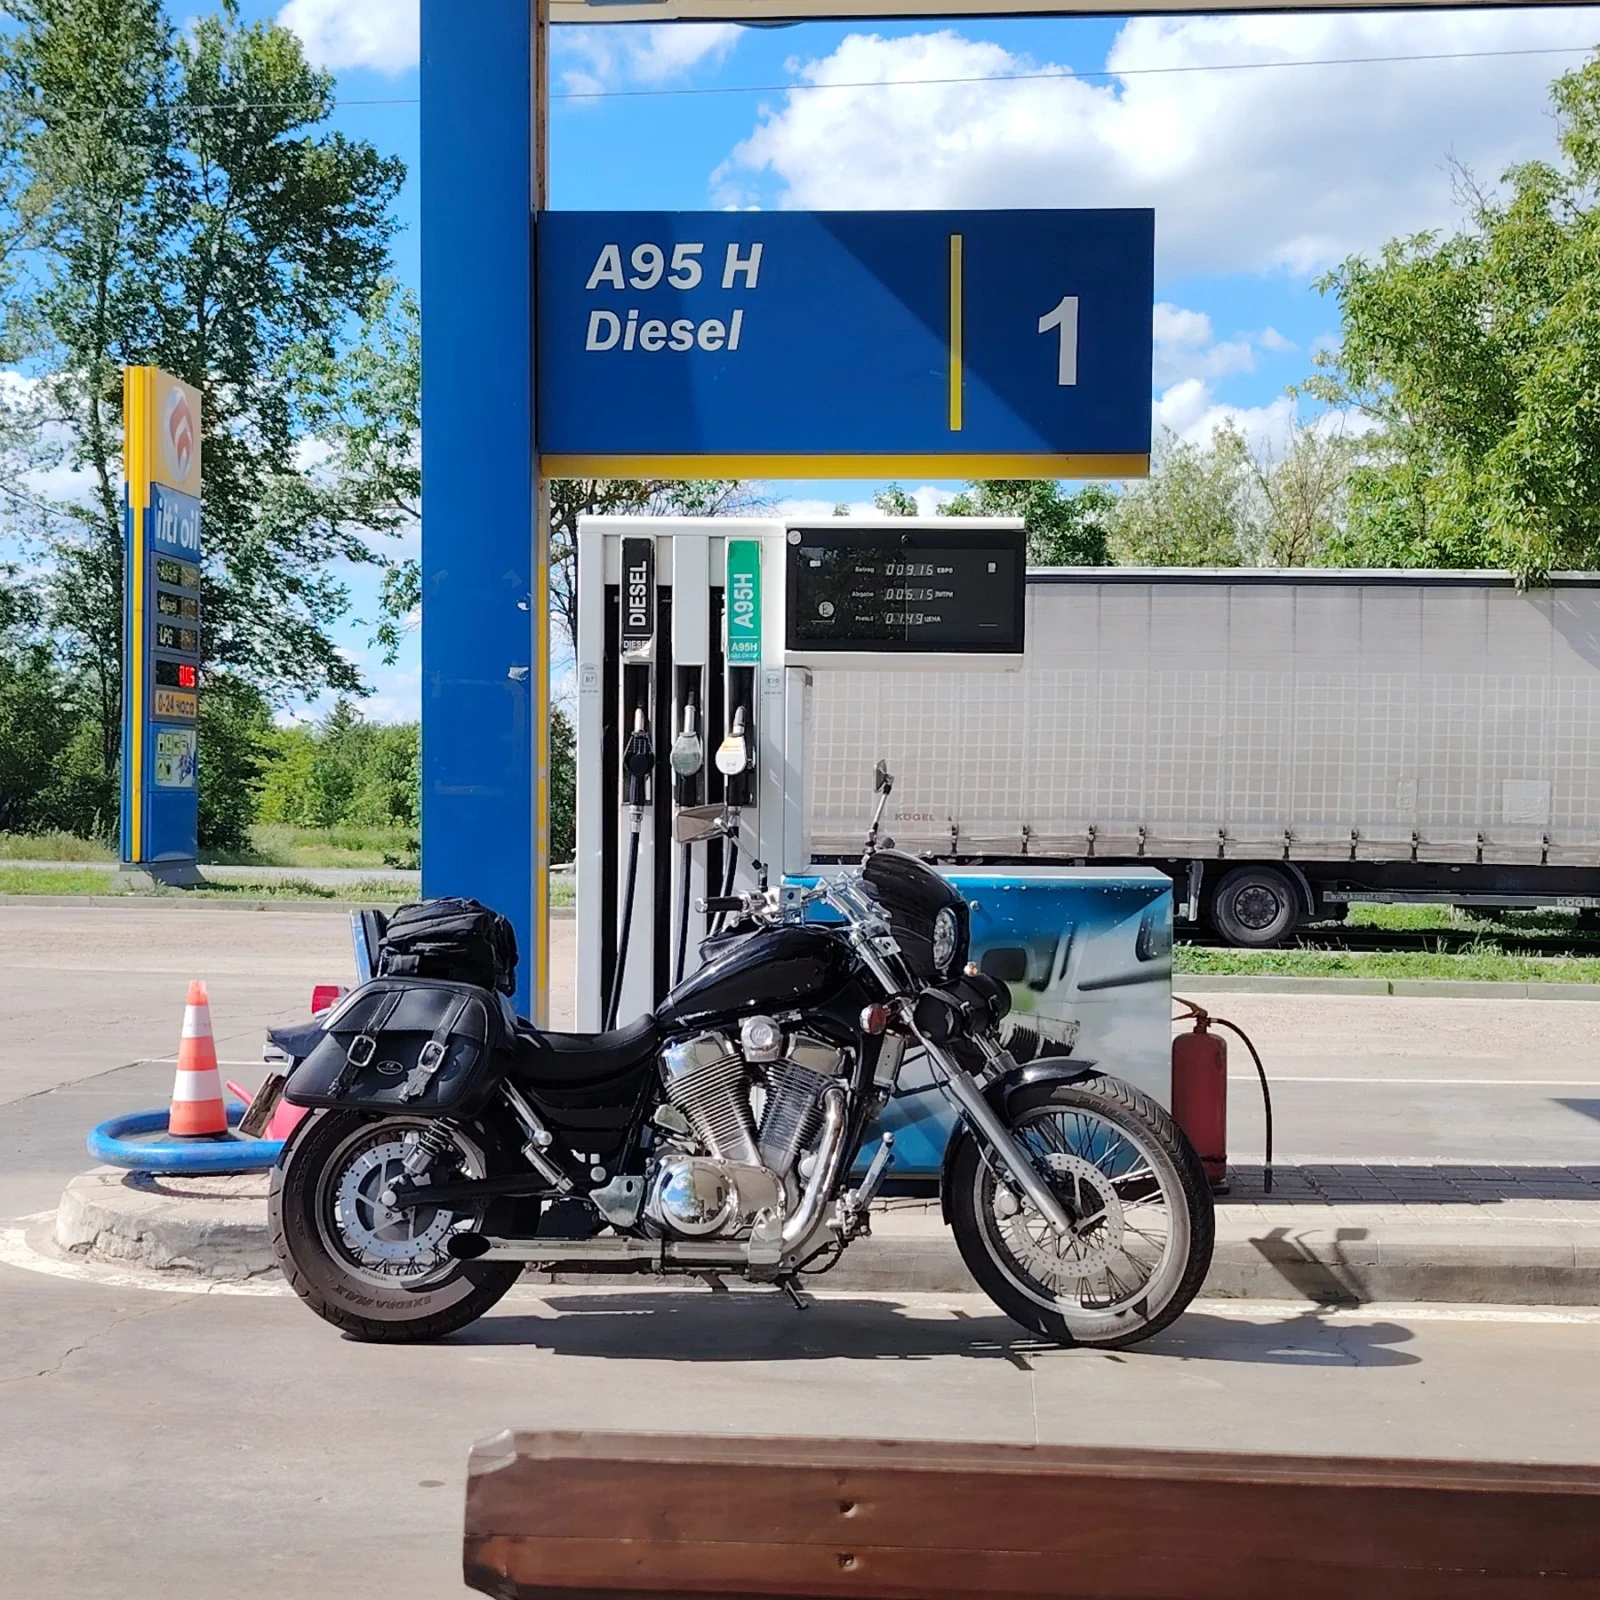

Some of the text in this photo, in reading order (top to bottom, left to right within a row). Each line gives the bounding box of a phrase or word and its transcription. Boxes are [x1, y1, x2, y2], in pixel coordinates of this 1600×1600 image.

[585, 242, 764, 290] A95 H
[585, 308, 744, 352] Diesel
[1037, 295, 1079, 386] 1
[629, 560, 647, 626] DIESEL
[733, 573, 754, 629] A95H
[159, 626, 174, 645] LPG
[731, 642, 758, 652] A95H
